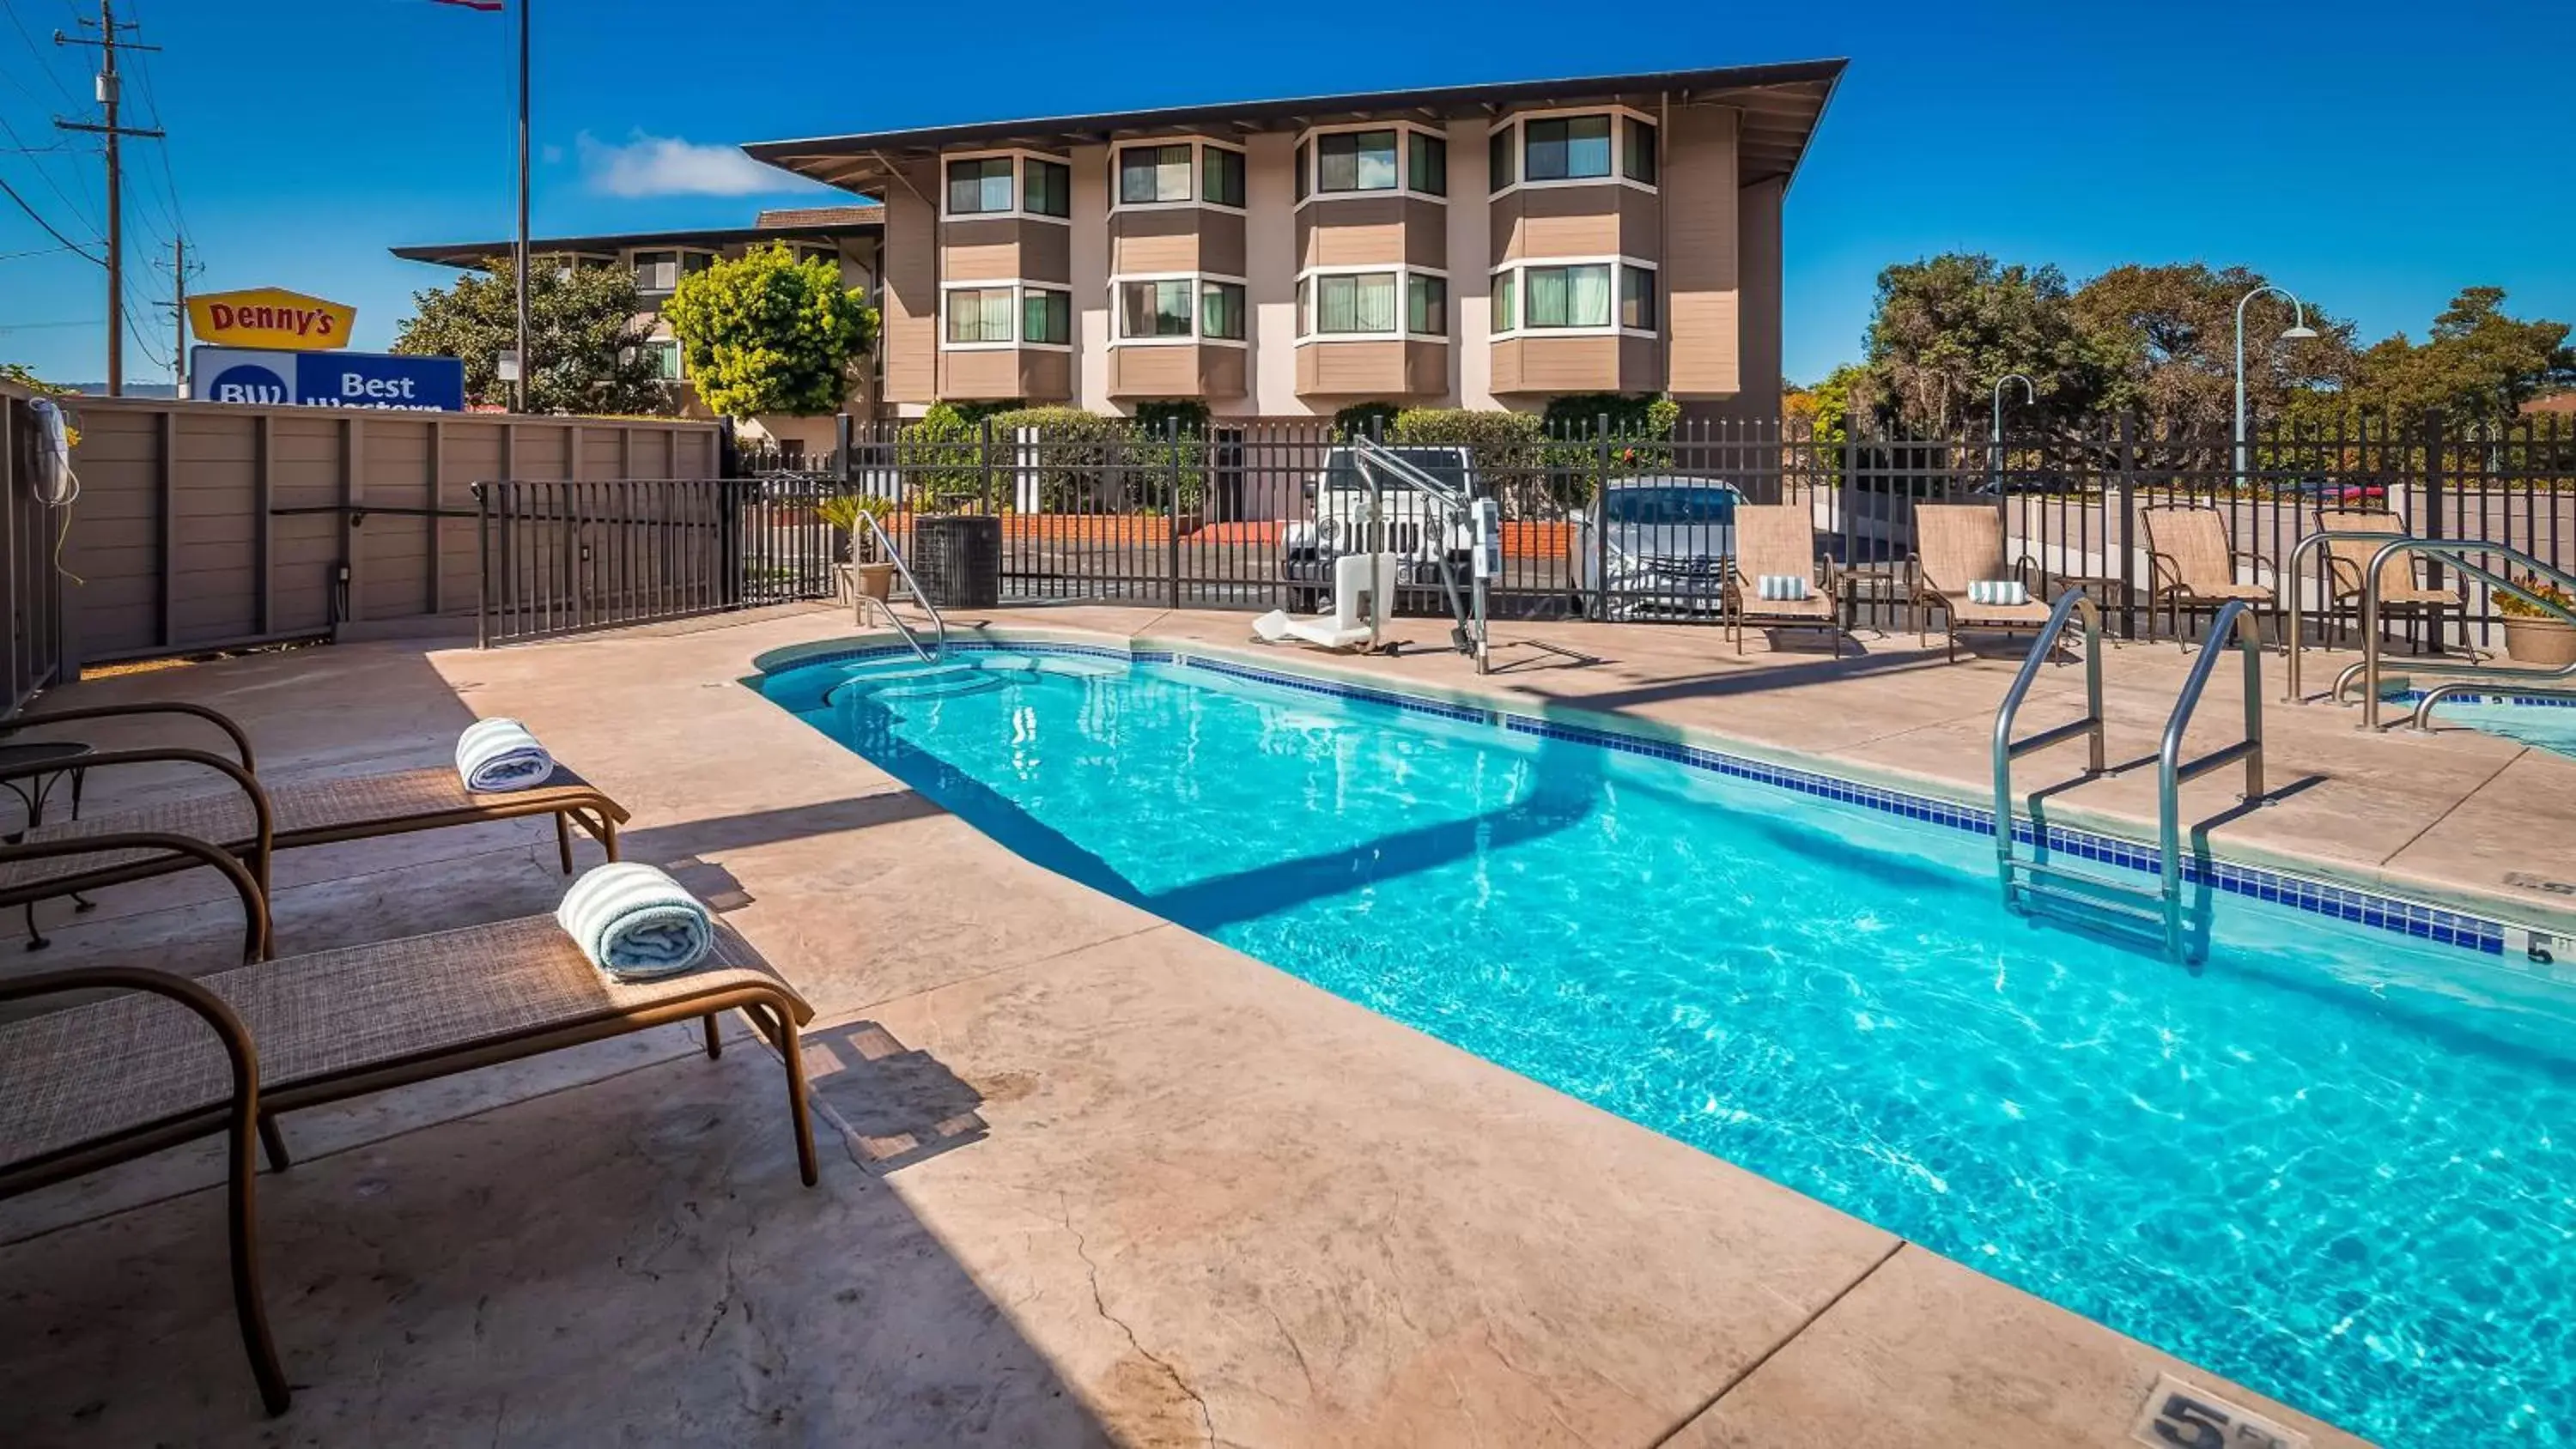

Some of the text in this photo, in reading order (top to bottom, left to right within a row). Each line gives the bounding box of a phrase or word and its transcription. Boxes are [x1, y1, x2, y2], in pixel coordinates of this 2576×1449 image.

[209, 303, 335, 336] Denny's
[220, 384, 282, 404] BW
[342, 373, 416, 399] Best
[2527, 931, 2554, 966] 5
[2154, 1391, 2230, 1449] 5
